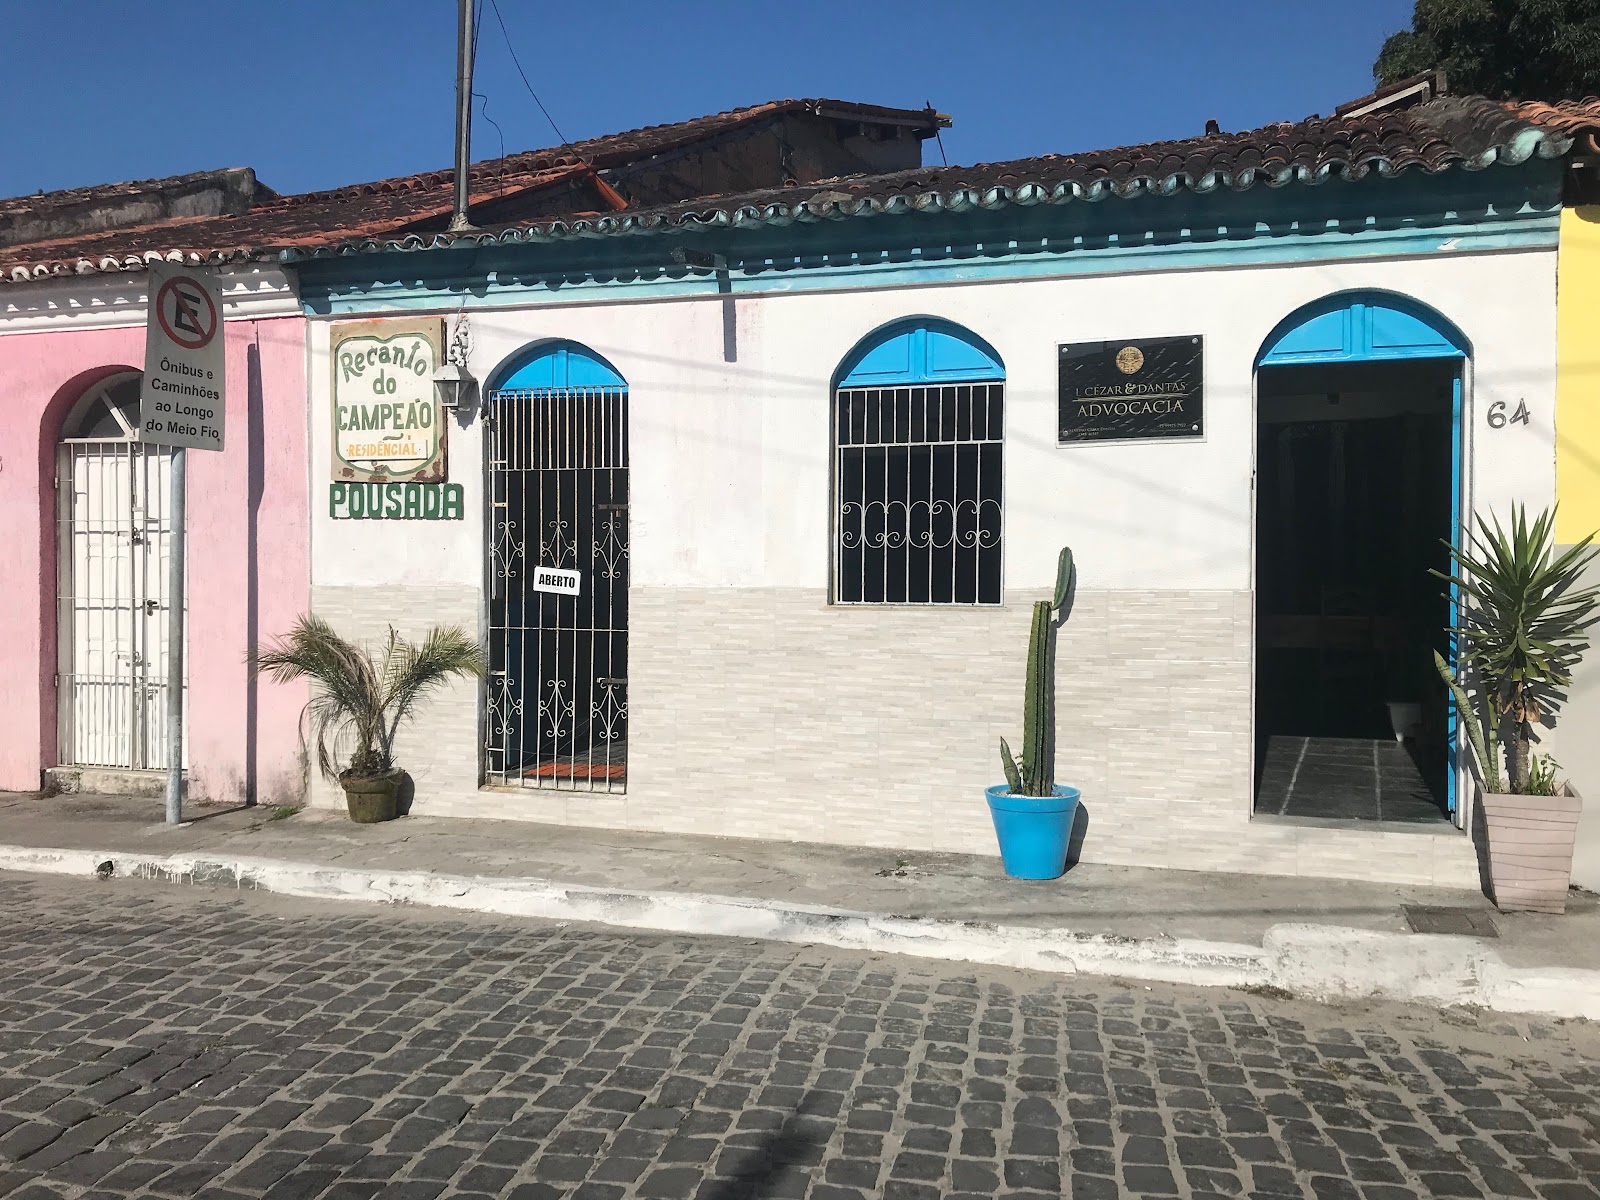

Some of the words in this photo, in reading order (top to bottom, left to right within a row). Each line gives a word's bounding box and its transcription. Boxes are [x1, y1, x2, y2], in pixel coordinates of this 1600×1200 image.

[160, 357, 204, 378] Ônibus
[206, 369, 213, 379] e
[339, 341, 427, 383] Recanto
[151, 378, 220, 400] Caminhões
[372, 368, 397, 394] do
[1124, 382, 1137, 395] &
[1136, 381, 1186, 394] DANTAS
[155, 402, 171, 412] ao
[175, 402, 214, 420] Longo
[1077, 399, 1184, 417] ADVOCACIA
[1487, 397, 1531, 429] 64
[146, 419, 163, 431] do
[167, 421, 197, 436] Meio
[201, 426, 219, 439] Fio
[330, 483, 464, 520] POUSADA
[538, 573, 576, 589] ABERTO
